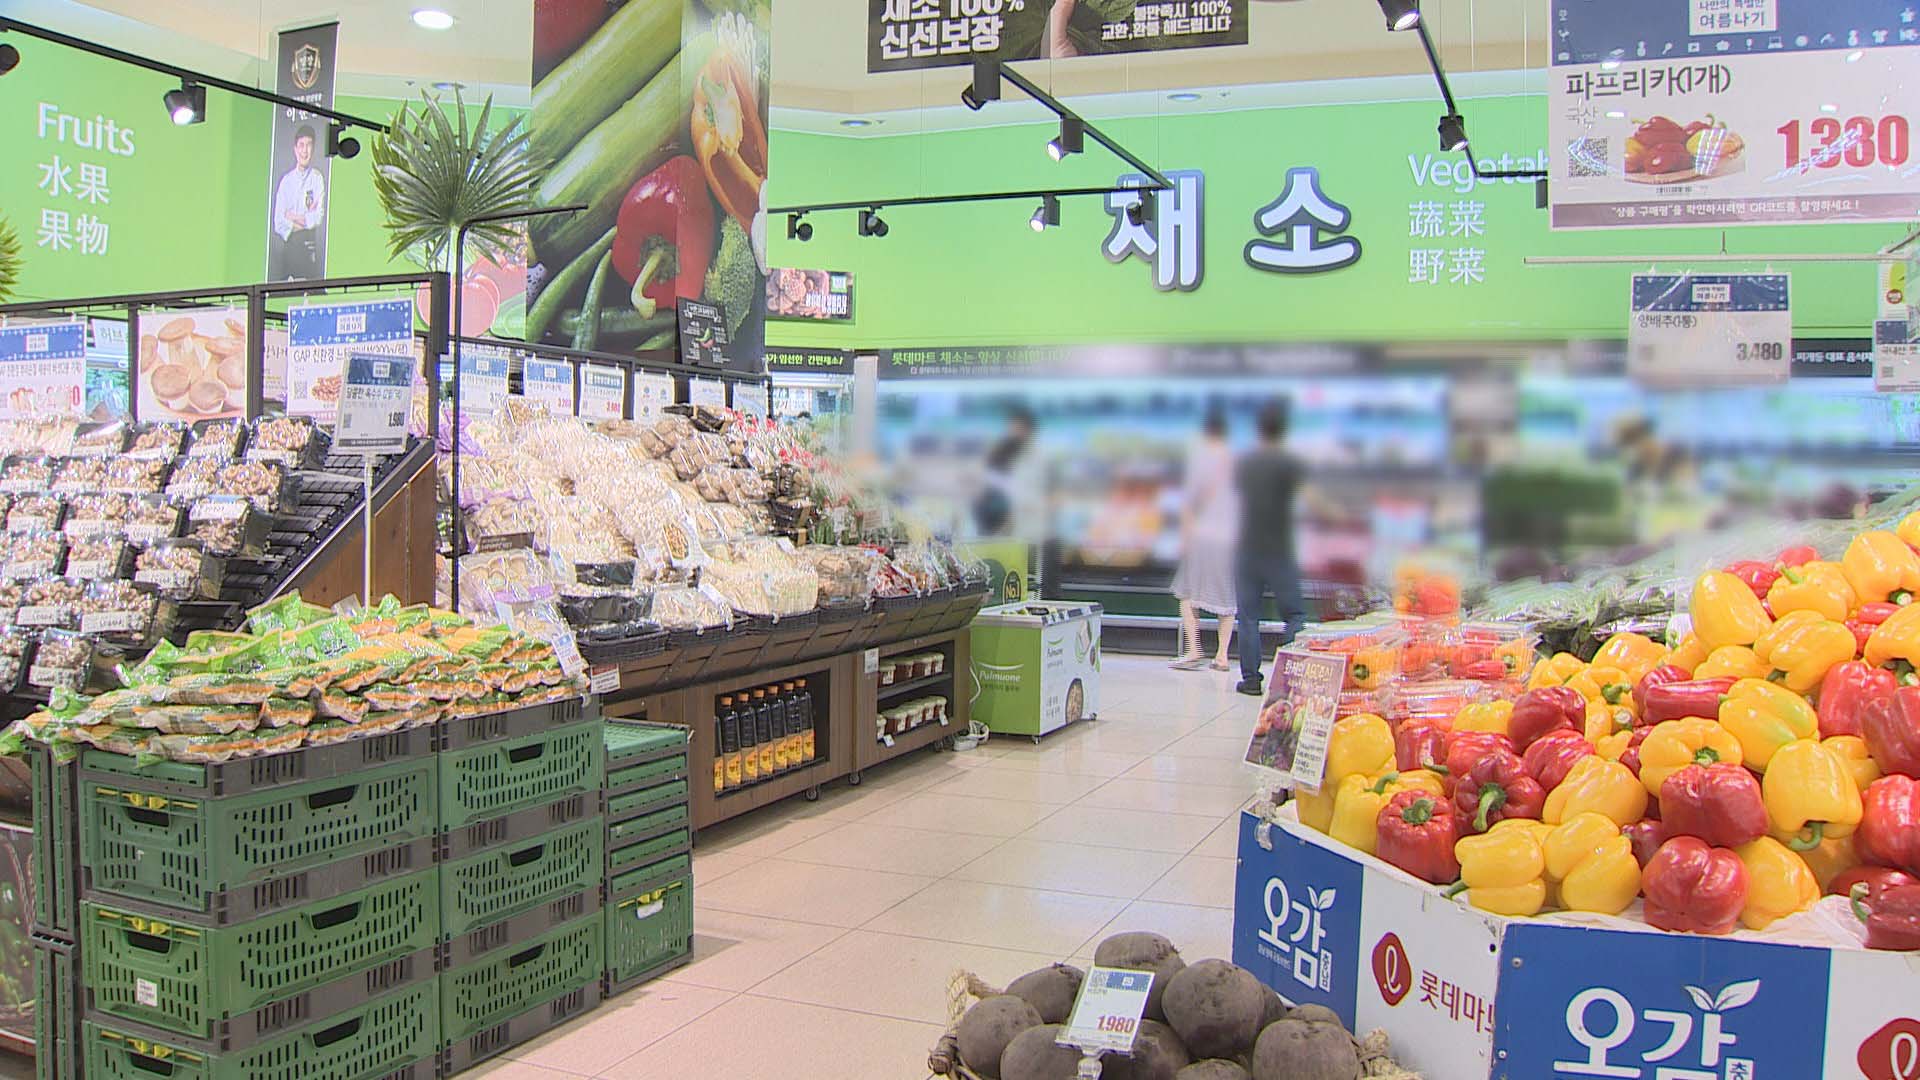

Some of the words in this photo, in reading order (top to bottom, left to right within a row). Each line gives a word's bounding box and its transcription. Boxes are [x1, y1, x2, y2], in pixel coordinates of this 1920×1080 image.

[1163, 15, 1232, 36] 해드립니다
[1190, 0, 1232, 17] 100%
[1700, 11, 1765, 29] 여름나기
[880, 15, 1004, 60] 신선보장
[1566, 64, 1731, 100] 파프리카(1개)
[38, 102, 136, 157] Fruits
[1777, 115, 1910, 176] 1,380
[37, 155, 110, 205] 水果
[37, 208, 110, 256] 果物
[1408, 200, 1486, 238] 蔬菜
[1408, 247, 1486, 285] 野菜
[892, 351, 938, 366] 롯데마트
[940, 351, 972, 365] 채소는
[979, 670, 1021, 683] Pulmuone
[1258, 877, 1327, 990] 오감
[1553, 986, 1737, 1080] 오감
